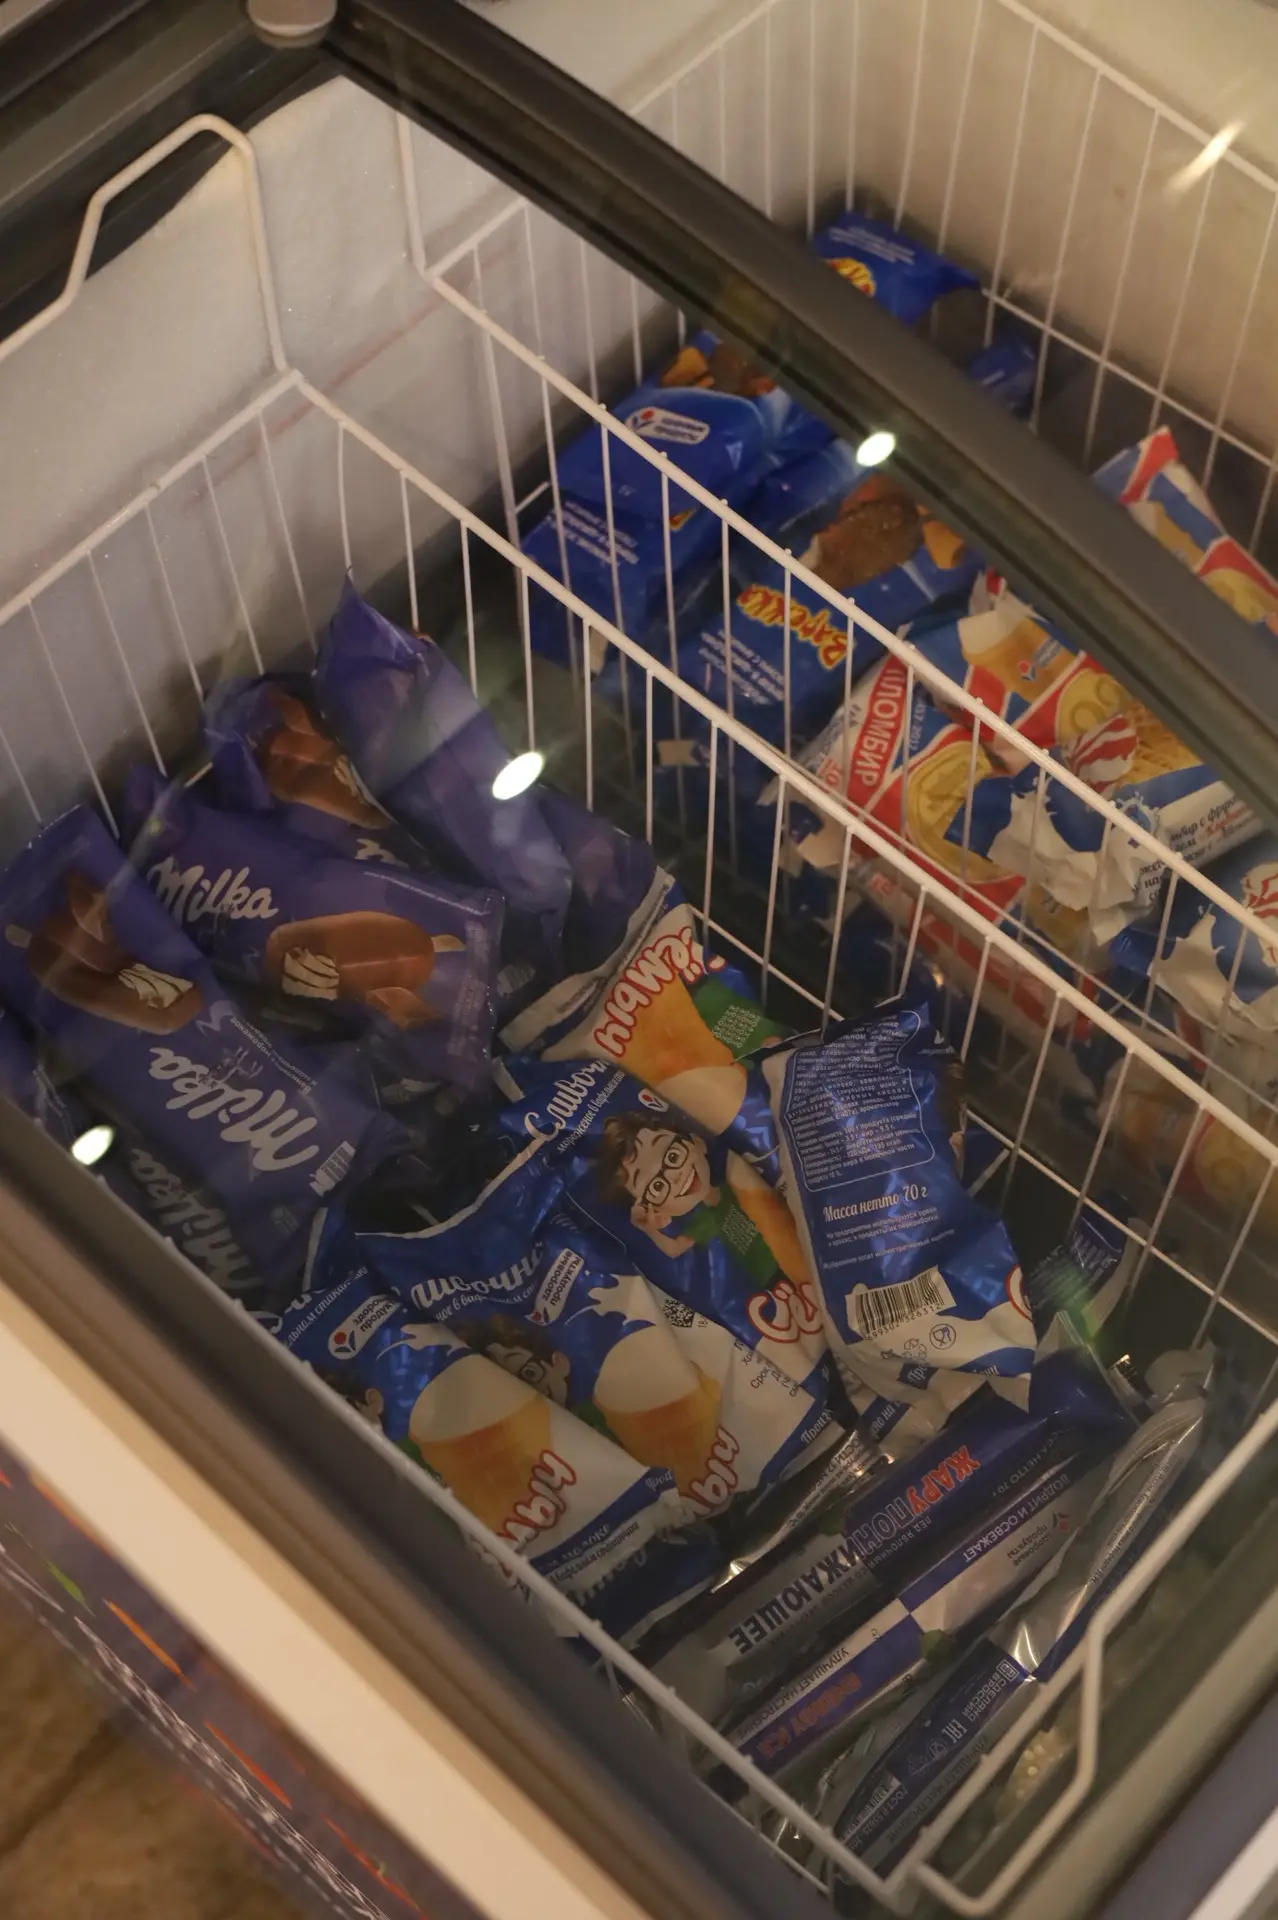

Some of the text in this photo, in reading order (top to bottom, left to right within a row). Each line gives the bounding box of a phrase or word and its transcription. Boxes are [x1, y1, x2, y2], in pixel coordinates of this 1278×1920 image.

[850, 665, 907, 788] ПЛОМБИР
[146, 855, 279, 918] Milka
[593, 925, 724, 1058] ёмыч
[150, 1047, 320, 1171] Milka
[517, 1052, 610, 1148] Сливочн
[555, 1107, 597, 1155] мороженое
[126, 1147, 262, 1292] Milka
[821, 1184, 929, 1222] Масса нетто 70 г
[541, 1249, 572, 1301] здоровые
[549, 1256, 581, 1306] продукты
[351, 1295, 384, 1326] здоро
[748, 1366, 773, 1390] Срок
[1025, 1472, 1070, 1512] БОДРИТ
[725, 1442, 983, 1656] ЖАРУПОНИЖАЮЩЕЕ
[959, 1513, 1020, 1563] ОСВЕЖАЕТ
[1005, 1522, 1048, 1560] продукты
[735, 1646, 848, 1739] УЛУЧШАЕТ НАСТРОЕНИЕ
[960, 1678, 995, 1717] РОССИИ
[966, 1677, 1007, 1722] СДЕЛАНО
